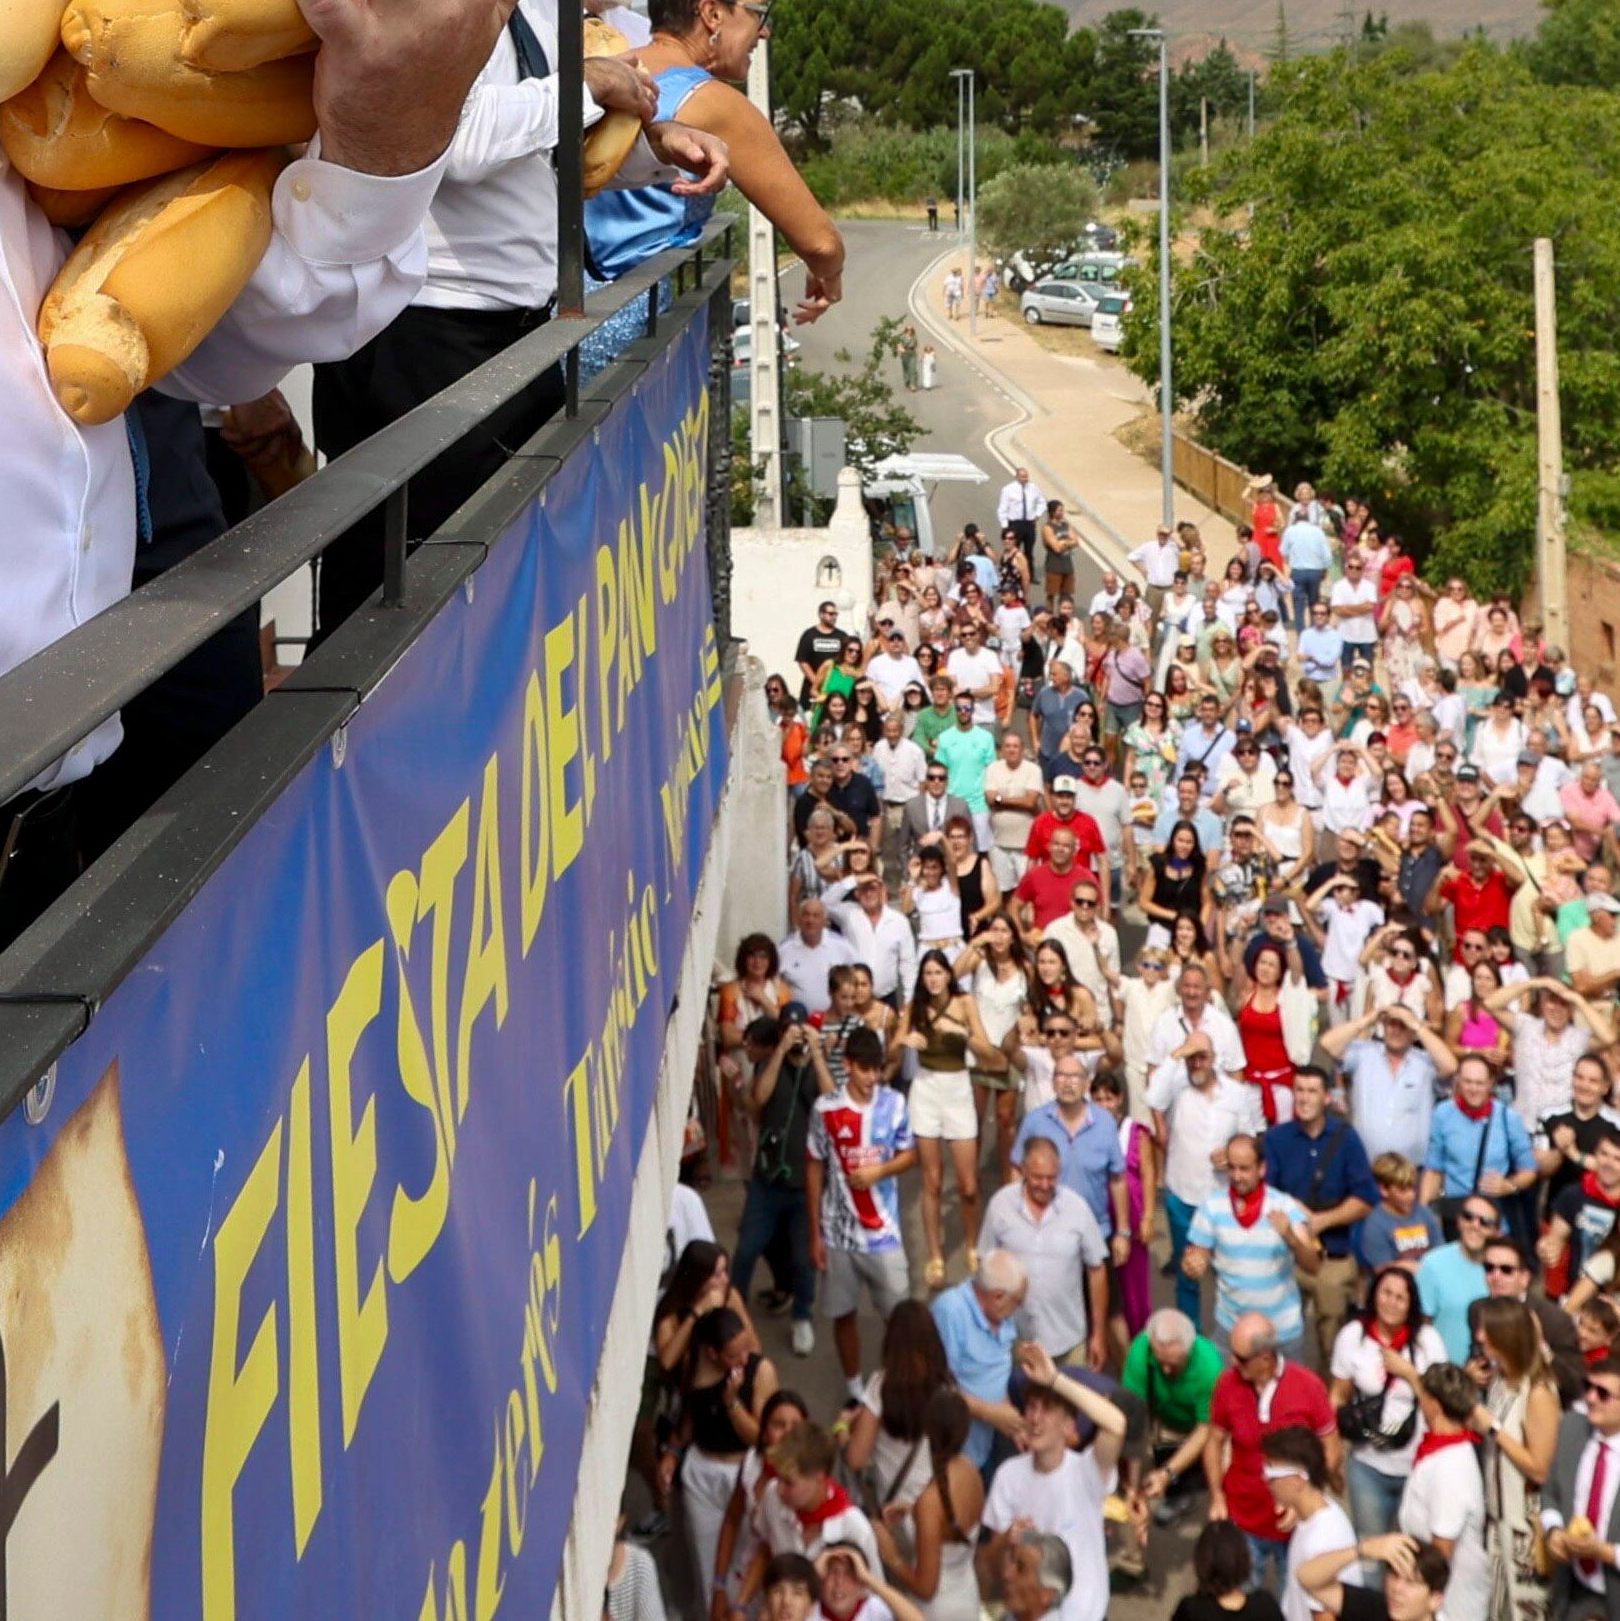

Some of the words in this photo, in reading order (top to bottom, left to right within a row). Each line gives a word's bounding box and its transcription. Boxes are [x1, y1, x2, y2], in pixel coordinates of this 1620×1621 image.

[201, 750, 507, 1621] FIESTA
[521, 593, 597, 959] DEL
[596, 482, 656, 764] PAN
